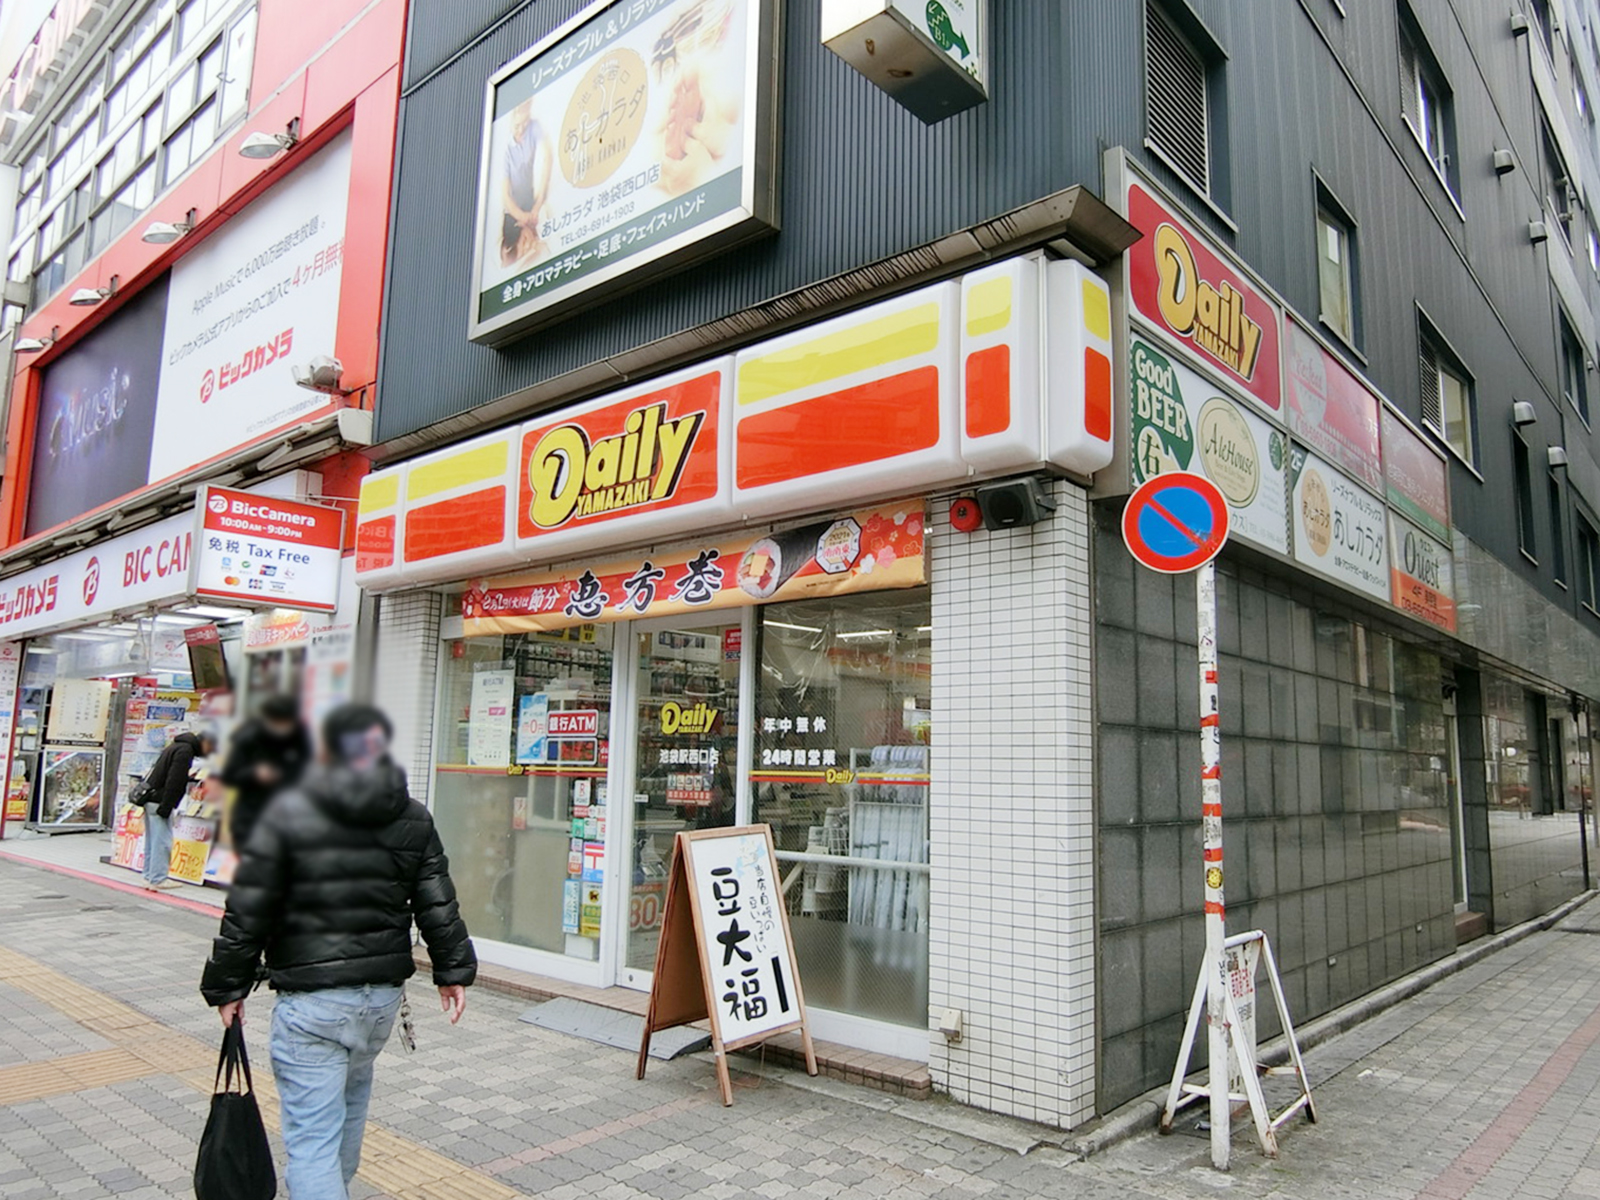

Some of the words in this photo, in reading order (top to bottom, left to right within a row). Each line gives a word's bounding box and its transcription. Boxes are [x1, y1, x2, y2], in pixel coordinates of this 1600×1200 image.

[541, 197, 594, 238] あしカラダ
[597, 163, 661, 208] 池袋西口店
[1154, 223, 1262, 381] Daily
[219, 326, 294, 390] ビックカメラ
[1193, 321, 1240, 373] YAMAZAKI
[1135, 348, 1174, 396] Good
[1136, 379, 1189, 441] BEER
[530, 401, 704, 530] Daily
[231, 500, 316, 527] BicCamera
[576, 479, 652, 518] YAMAZAKI
[208, 537, 240, 554] 免税
[247, 543, 273, 559] Tax
[278, 548, 310, 564] Free
[1334, 506, 1384, 566] あしカラダ
[123, 545, 153, 588] BIC
[564, 548, 724, 619] 恵方巻
[548, 715, 596, 732] 銀行ATM
[661, 702, 718, 734] Daily
[763, 716, 826, 733] 年中無休
[659, 748, 720, 765] 池袋駅西口店
[762, 748, 836, 766] 24時間営業
[825, 768, 855, 784] Daily
[710, 866, 769, 1022] 豆大福
